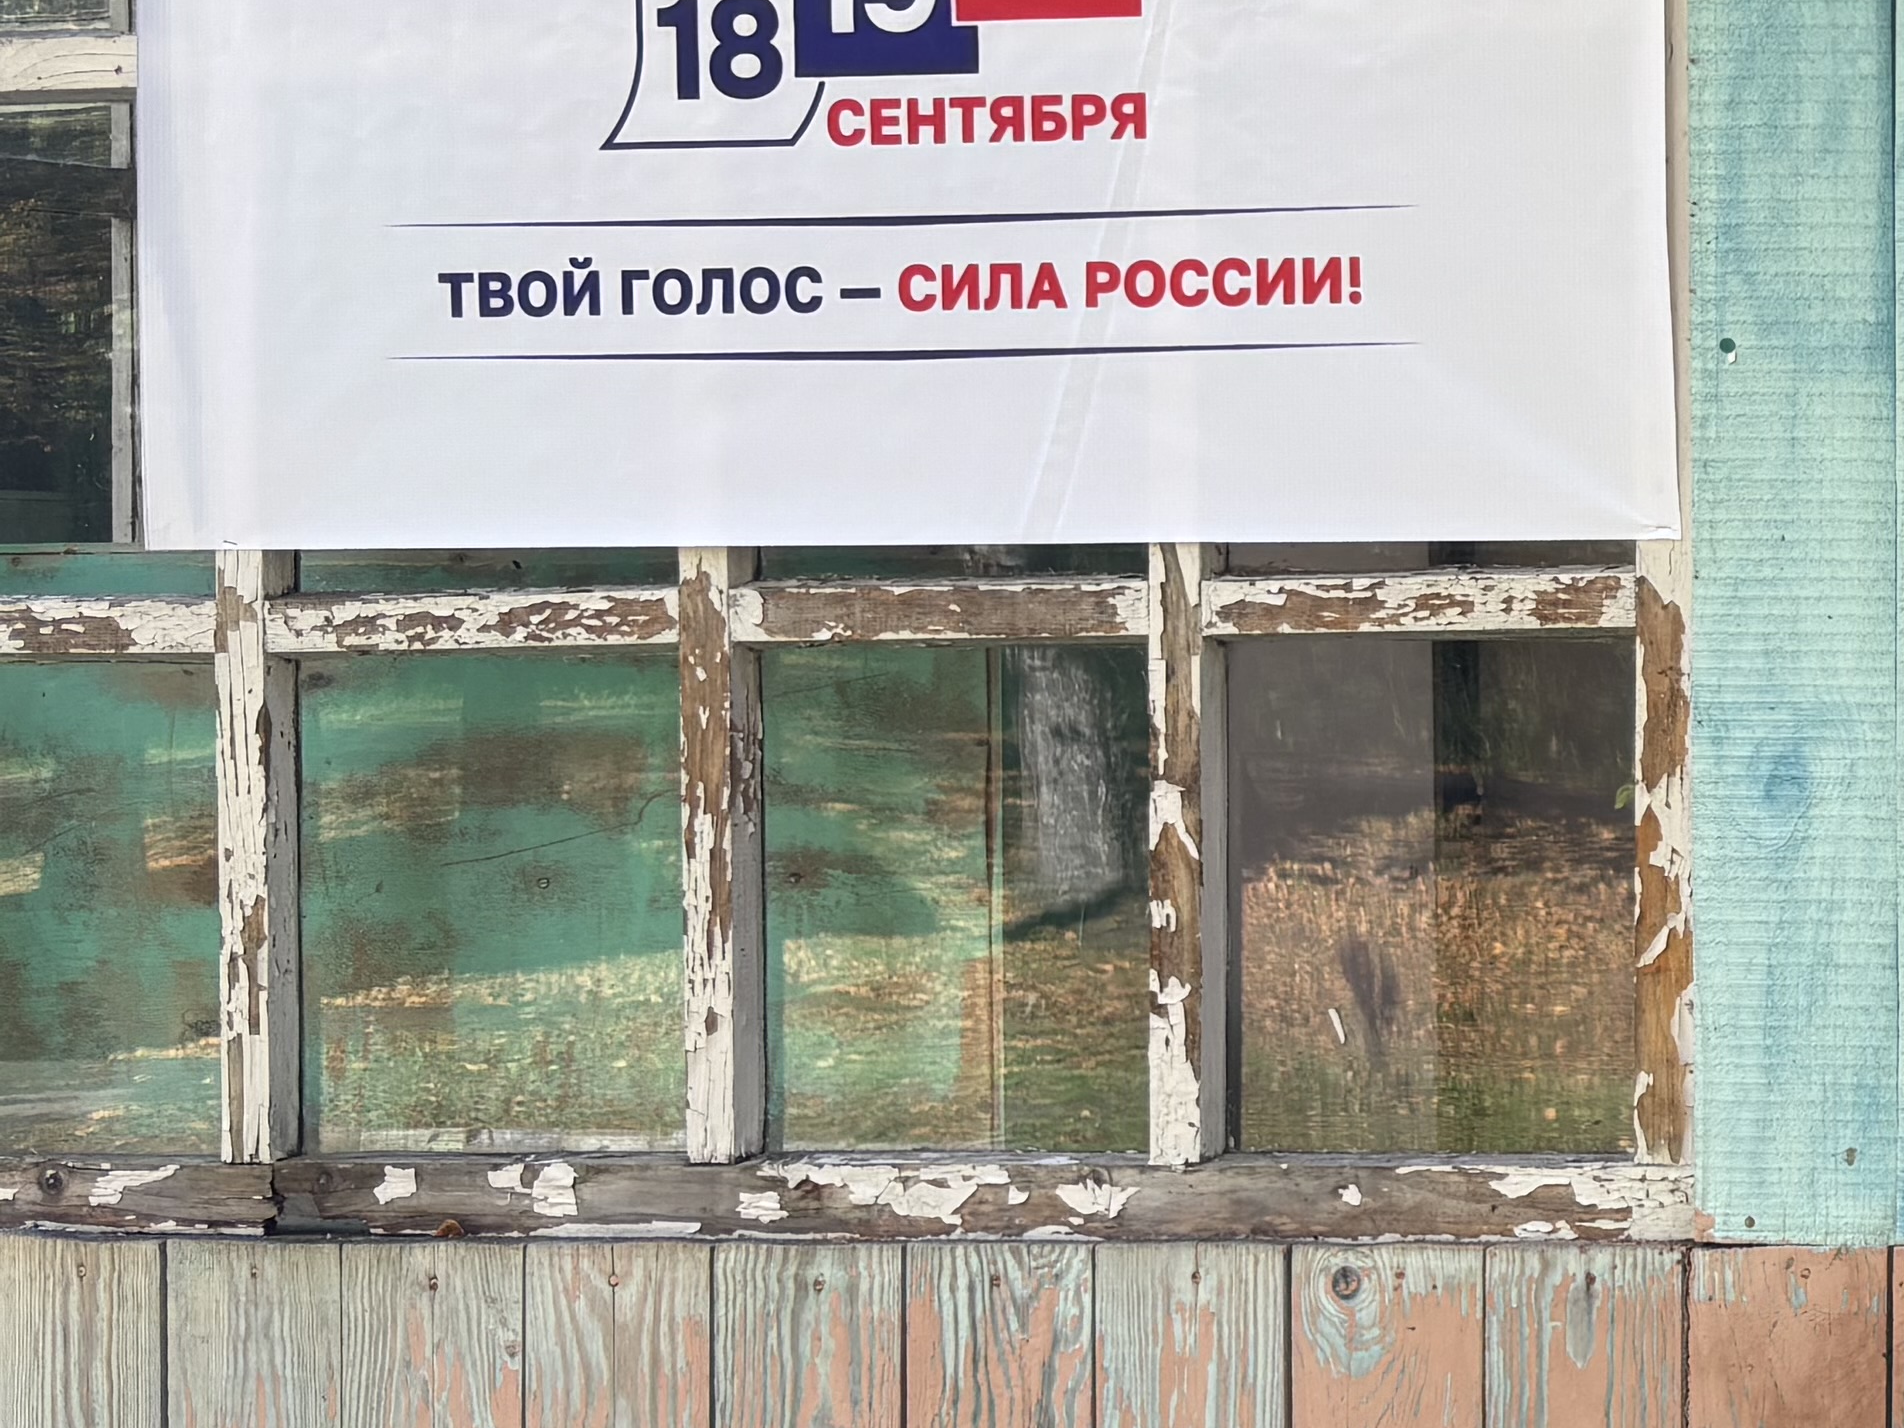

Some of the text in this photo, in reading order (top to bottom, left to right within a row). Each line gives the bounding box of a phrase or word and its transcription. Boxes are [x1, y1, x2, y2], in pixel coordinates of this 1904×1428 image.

[825, 92, 1148, 146] СЕНТЯБРЯ
[438, 257, 600, 318] ТВОЙ
[621, 265, 823, 315] ГОЛОС
[897, 261, 1066, 311] СИЛА
[1084, 257, 1363, 307] РОССИИ!
